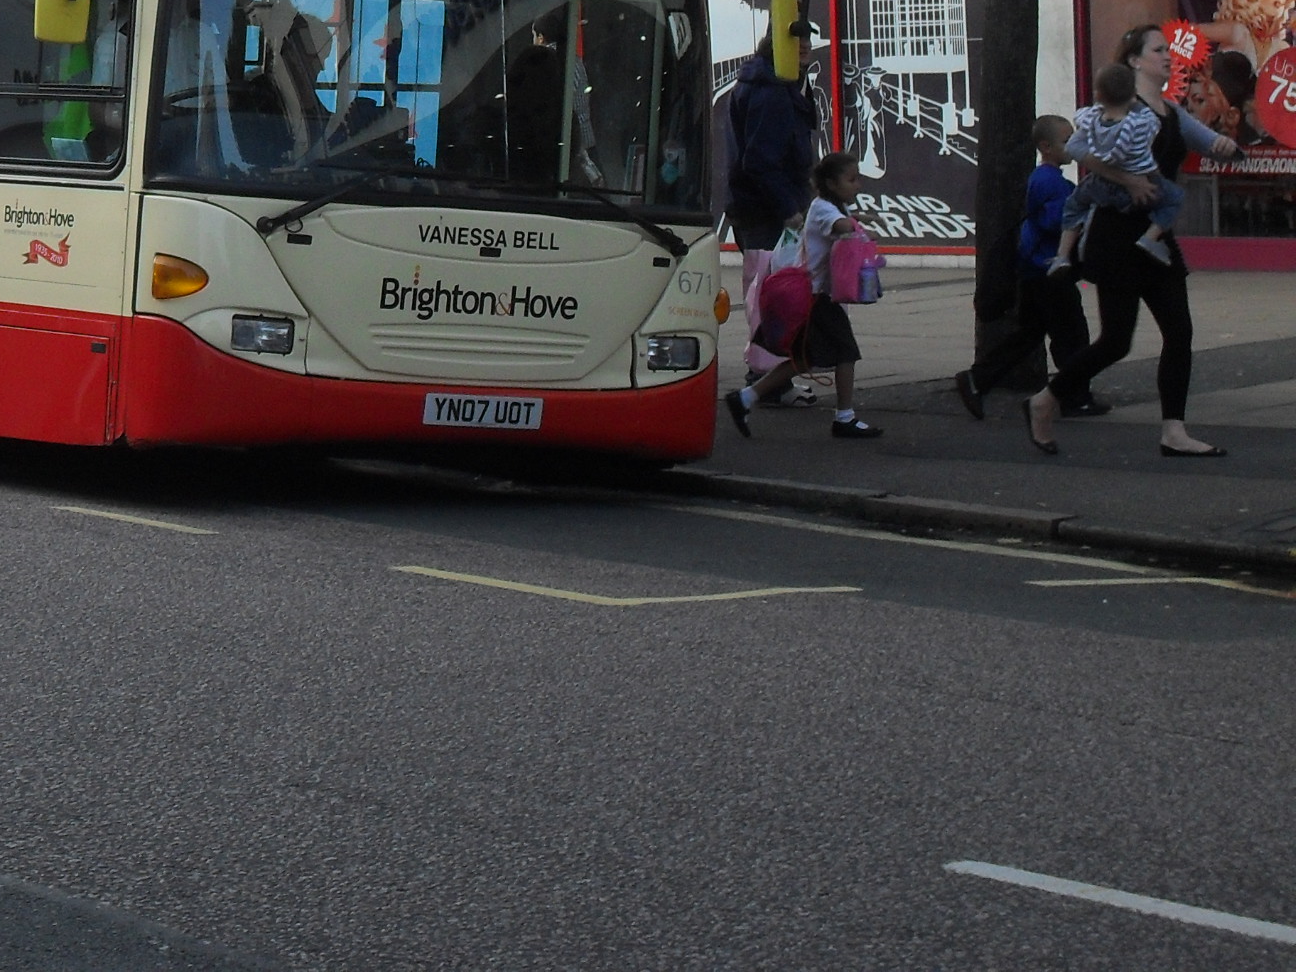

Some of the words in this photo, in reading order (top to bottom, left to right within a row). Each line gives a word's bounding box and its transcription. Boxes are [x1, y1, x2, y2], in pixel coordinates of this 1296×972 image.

[1169, 43, 1193, 59] PRICE
[1174, 28, 1197, 52] 1/2
[1274, 56, 1294, 78] Up
[847, 193, 951, 213] RAND
[418, 225, 506, 248] VANESSA
[513, 230, 560, 251] BELL
[678, 270, 712, 296] 671
[435, 397, 489, 423] YN07
[495, 401, 535, 425] UOT
